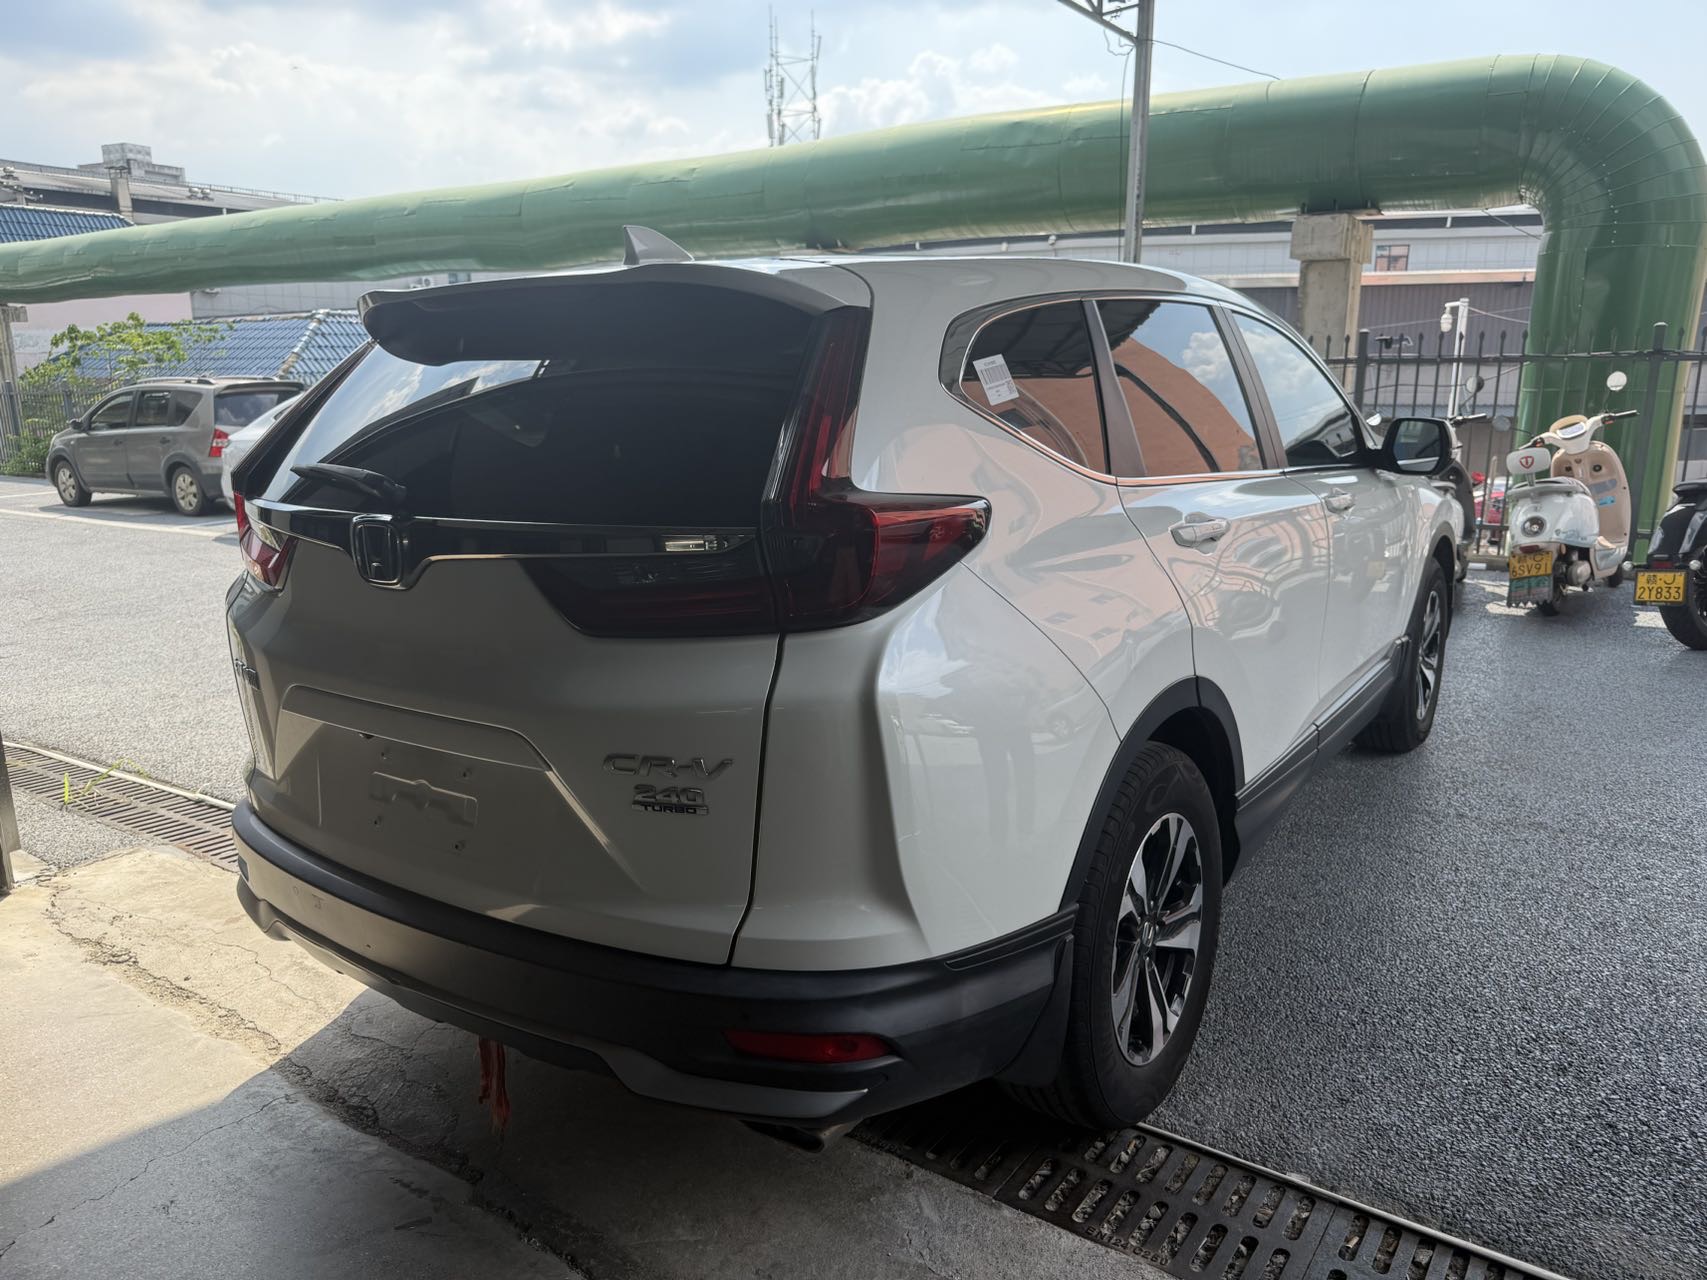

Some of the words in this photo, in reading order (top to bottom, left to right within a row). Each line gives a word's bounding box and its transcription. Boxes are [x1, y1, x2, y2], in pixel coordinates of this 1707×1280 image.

[1637, 586, 1681, 600] 2Y833
[603, 753, 734, 779] CR-V
[632, 784, 704, 805] 240
[641, 803, 698, 815] TURBO
